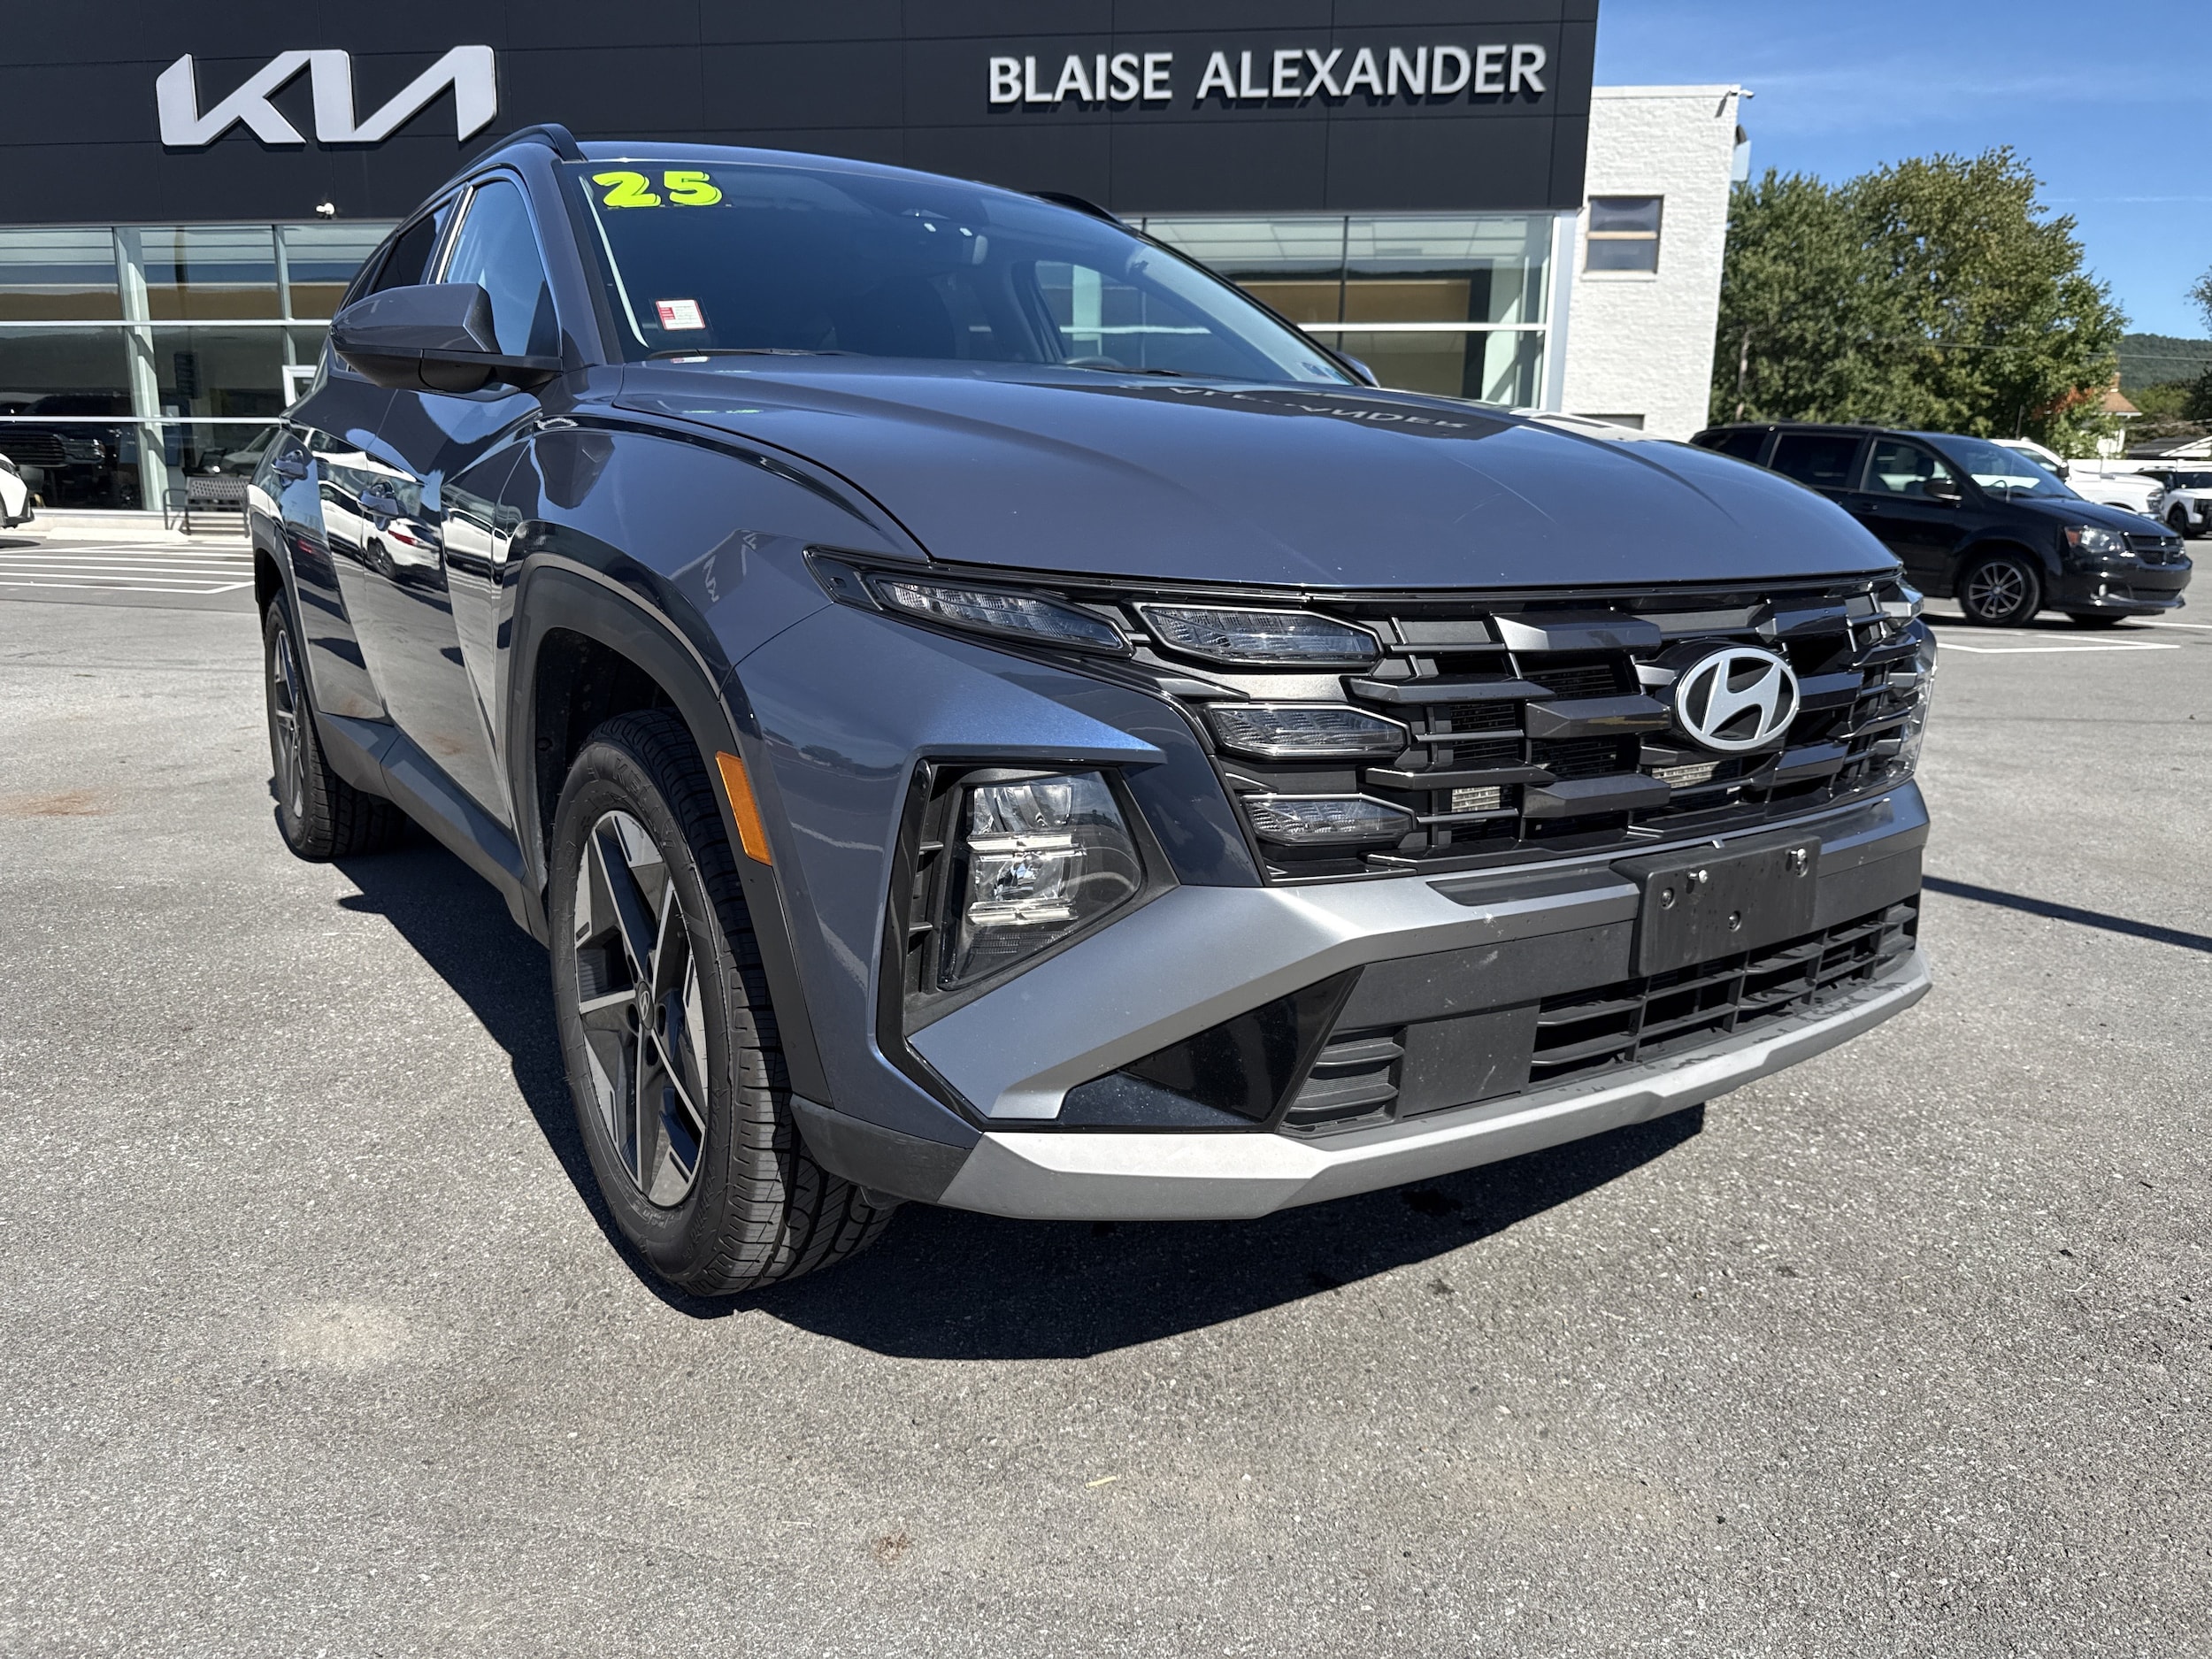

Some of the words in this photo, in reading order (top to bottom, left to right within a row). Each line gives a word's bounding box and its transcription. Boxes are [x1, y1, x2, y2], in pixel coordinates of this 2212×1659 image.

[156, 44, 497, 146] KIA
[988, 51, 1173, 104] BLAISE
[1195, 43, 1548, 99] ALEXANDER
[592, 171, 723, 208] 25
